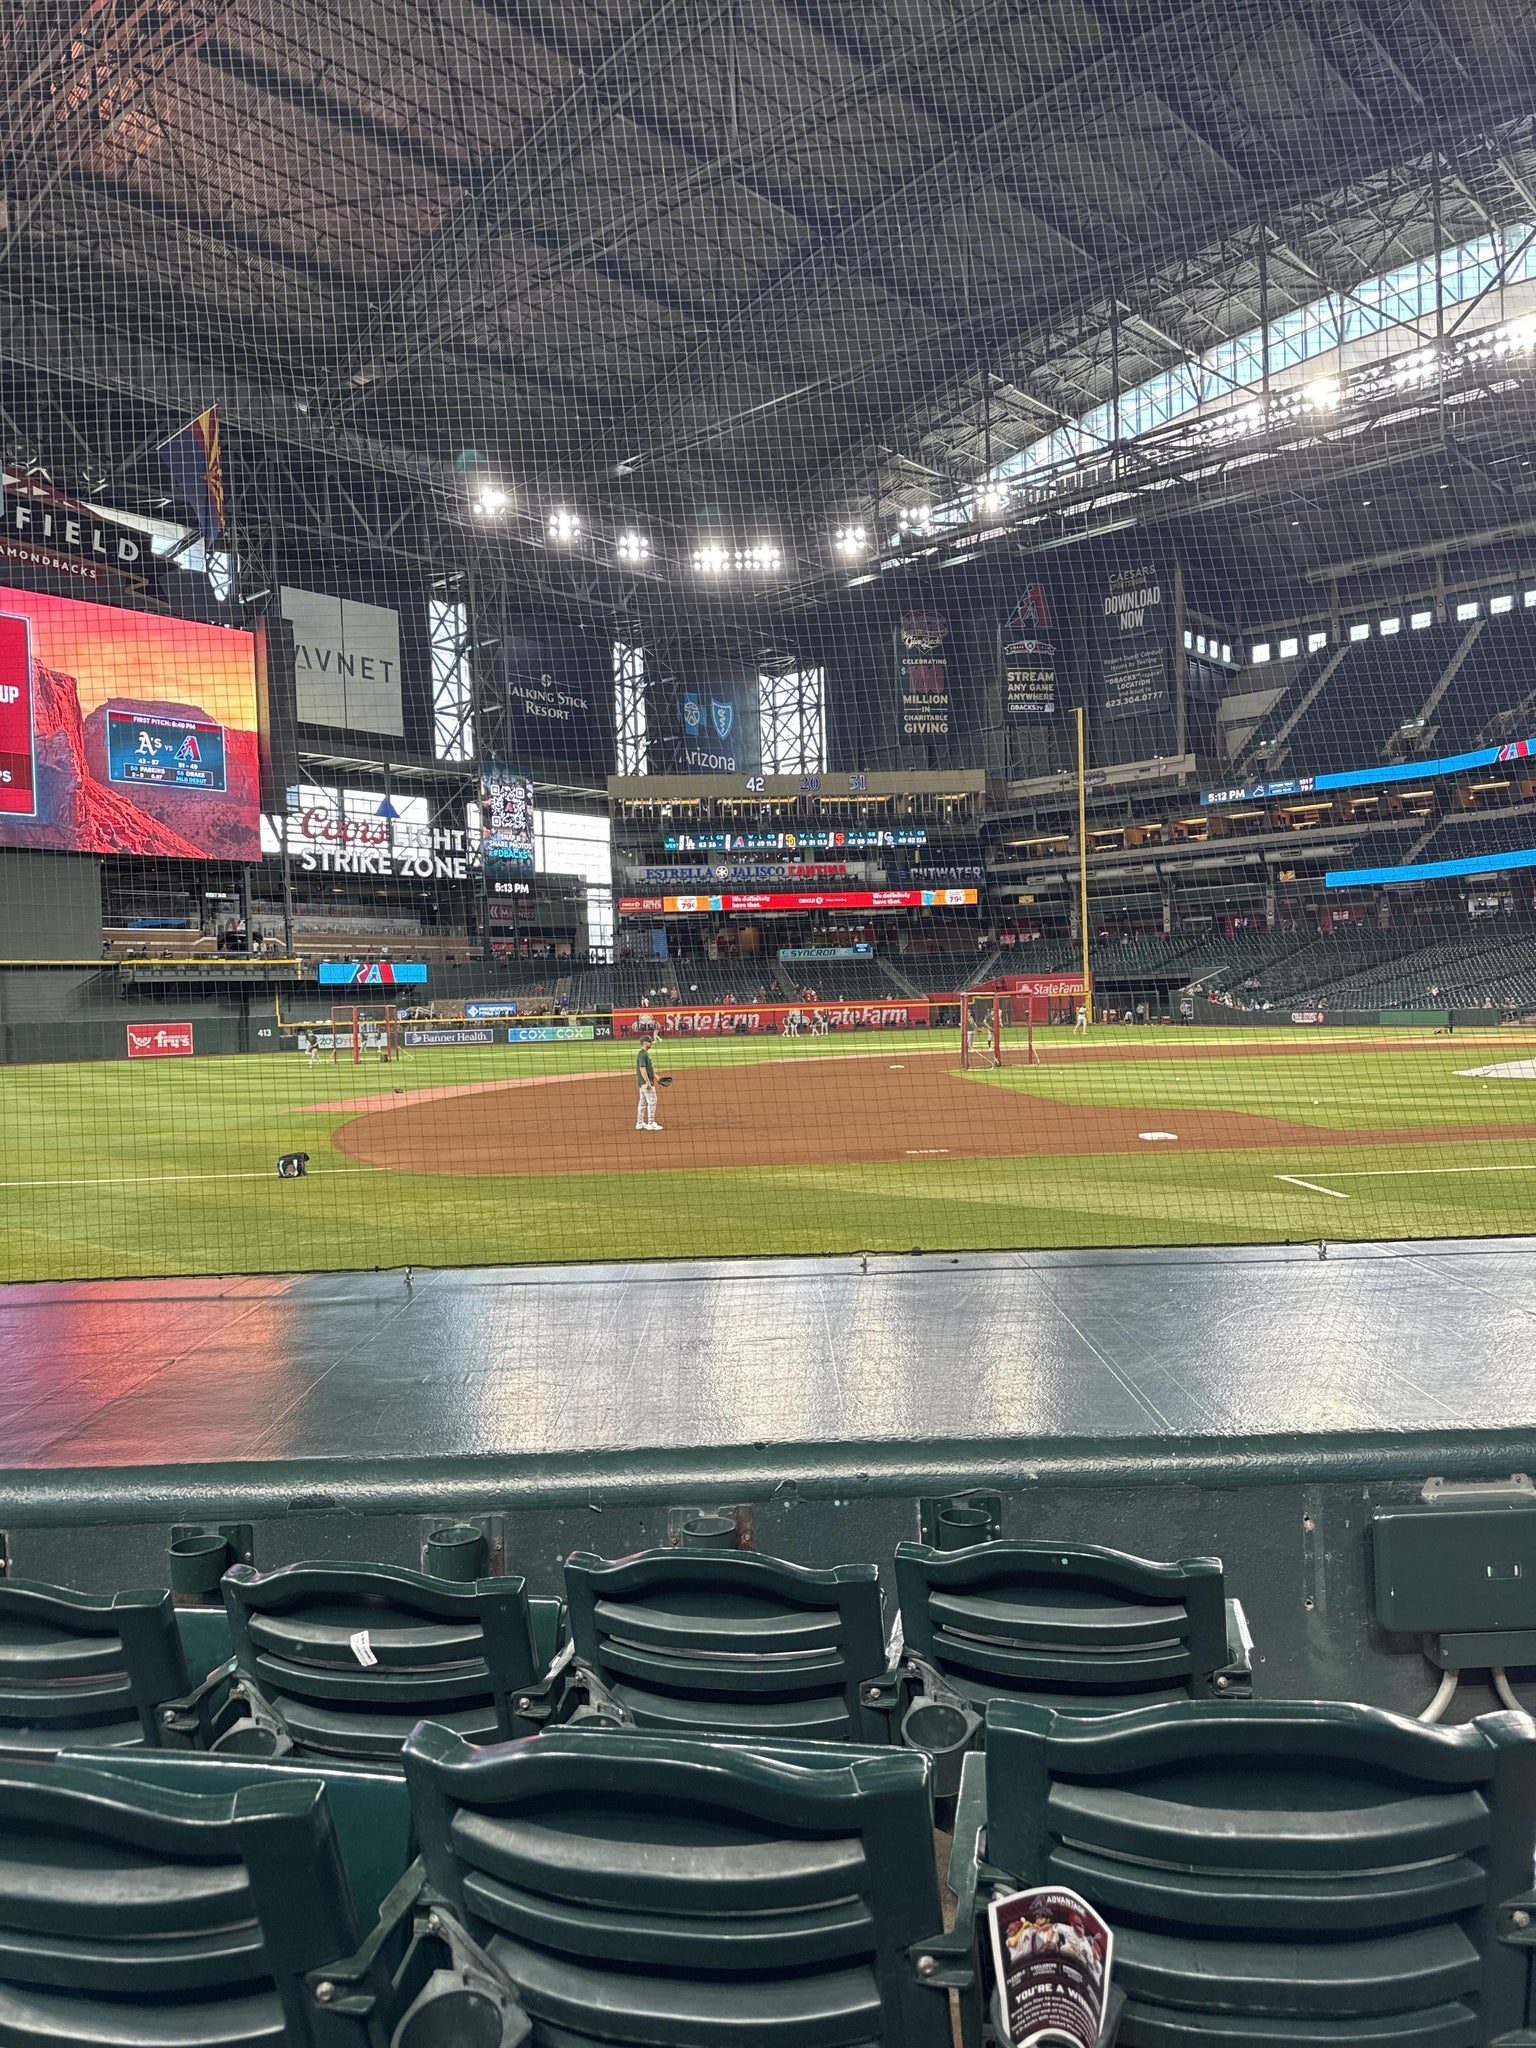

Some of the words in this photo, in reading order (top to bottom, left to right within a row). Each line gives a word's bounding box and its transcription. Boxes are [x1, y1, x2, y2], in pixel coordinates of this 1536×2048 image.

[16, 506, 139, 561] FIELD
[1109, 565, 1155, 583] CAESARS
[1105, 587, 1160, 615] DOWNLOAD
[1120, 608, 1144, 630] NOW
[295, 644, 393, 683] AVNET
[1007, 671, 1054, 682] STREAM
[1117, 678, 1151, 690] LOCATION
[1008, 683, 1026, 692] ANY
[1029, 683, 1054, 692] GAME
[902, 695, 948, 704] MILLION
[1105, 690, 1163, 708] 623.304.0777
[133, 716, 150, 724] FIRST
[904, 723, 949, 734] GIVING
[679, 747, 735, 772] Arizona
[746, 777, 765, 792] 42
[800, 776, 820, 791] 20
[849, 775, 867, 790] 51
[1208, 791, 1227, 802] 5:12
[1229, 789, 1245, 800] PM
[301, 806, 388, 844] Coors
[392, 823, 465, 851] LIGHT
[509, 842, 532, 850] PHOTOS
[493, 849, 528, 859] #DBACKS
[301, 847, 392, 875] STRIKE
[397, 854, 467, 879] ZONE
[646, 867, 713, 880] ESTRELLA
[732, 866, 785, 878] JALISCO
[788, 864, 847, 876] CANTINA
[495, 882, 513, 893] 5:13
[514, 883, 529, 894] PM
[790, 949, 836, 957] SYNCRON
[154, 1030, 190, 1048] fry's
[257, 1028, 272, 1037] 413
[422, 1033, 455, 1043] Banner
[457, 1031, 487, 1041] Health
[519, 1030, 547, 1040] COX
[556, 1028, 584, 1039] COX
[596, 1028, 610, 1036] 374
[1046, 1895, 1087, 1917] ADVANTAGE
[1015, 1983, 1053, 2004] YOU'RE
[1056, 1984, 1064, 1994] A
